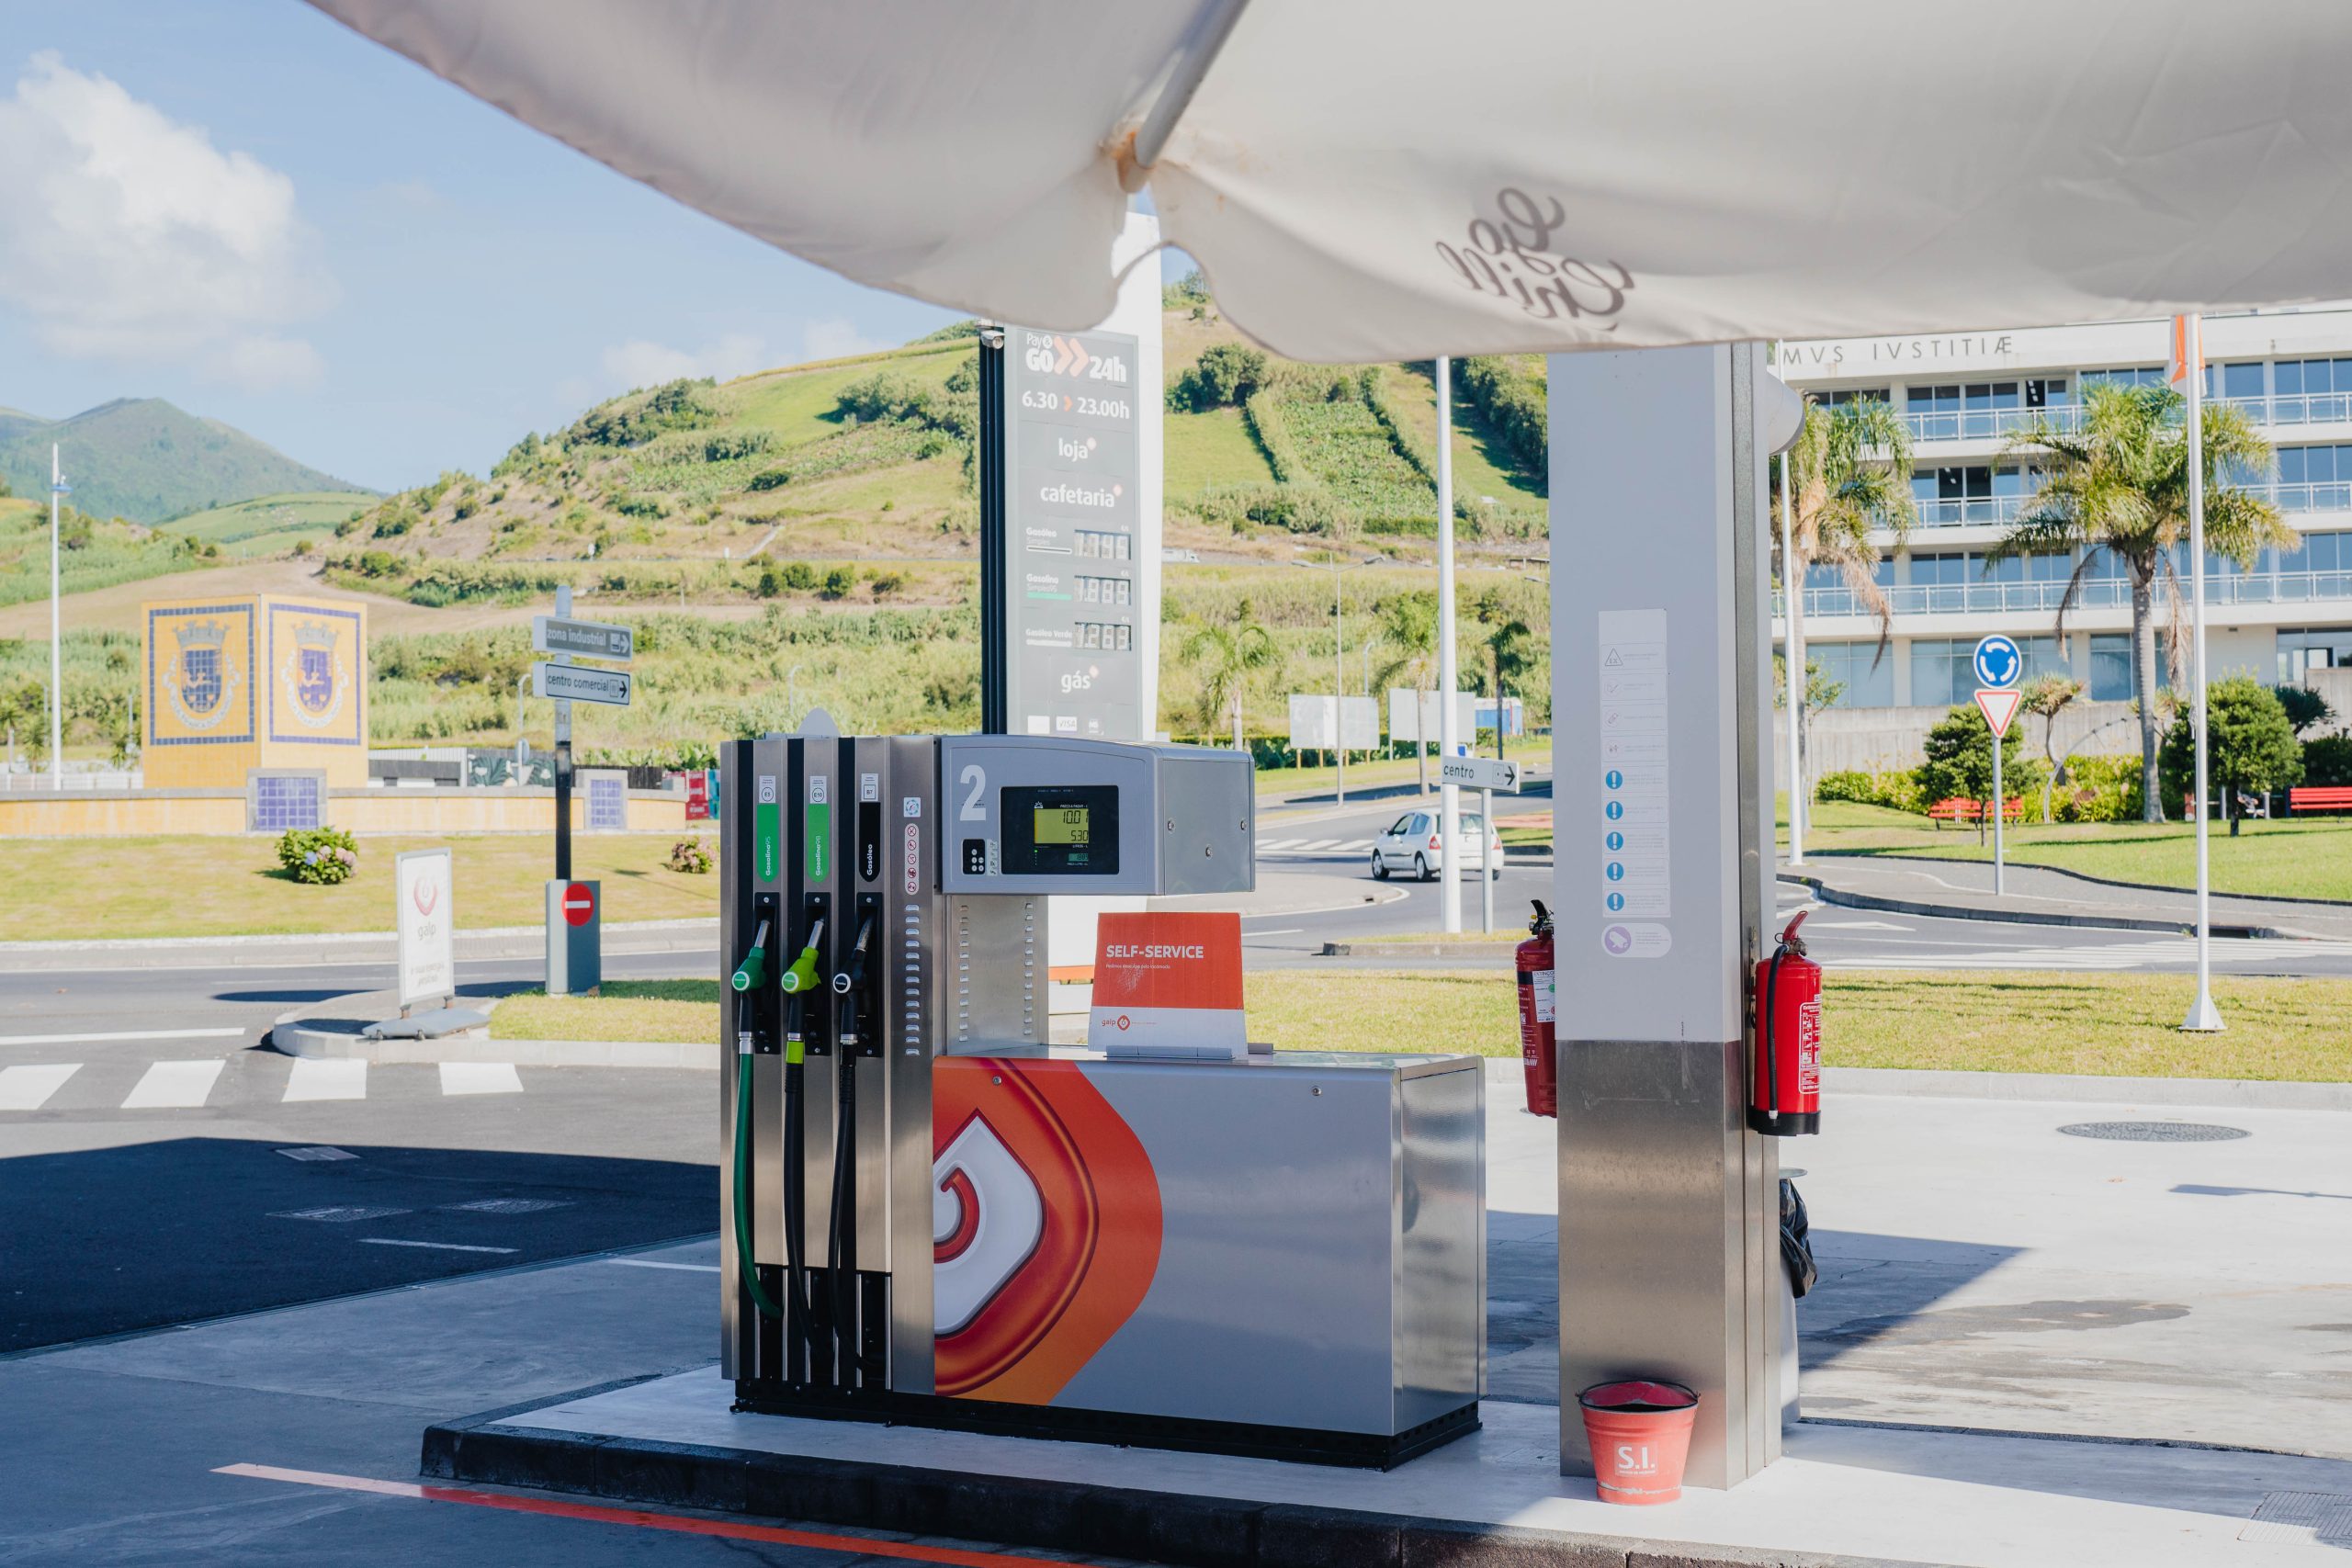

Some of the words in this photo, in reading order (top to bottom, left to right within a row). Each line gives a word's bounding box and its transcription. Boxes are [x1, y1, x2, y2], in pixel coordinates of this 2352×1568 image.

[1873, 336, 2012, 360] IVSTITIÆ
[1025, 347, 1055, 374] GO
[1089, 355, 1127, 383] 24h
[1022, 390, 1058, 411] 6.30
[1077, 397, 1130, 420] 23.00h
[1058, 436, 1089, 463] loja
[1040, 484, 1115, 508] cafetaria
[1025, 573, 1059, 584] Gasolina
[547, 627, 567, 641] zona
[568, 628, 606, 647] industrial
[548, 674, 571, 688] centro
[574, 679, 609, 692] comercial
[1061, 670, 1091, 694] gás
[1058, 719, 1076, 728] VISA
[1443, 763, 1475, 779] centro
[959, 764, 986, 821] 2
[417, 920, 436, 942] galp
[1105, 944, 1204, 959] SELF-SERVICE
[1102, 1019, 1116, 1027] galp
[1617, 1445, 1656, 1470] S.I.
